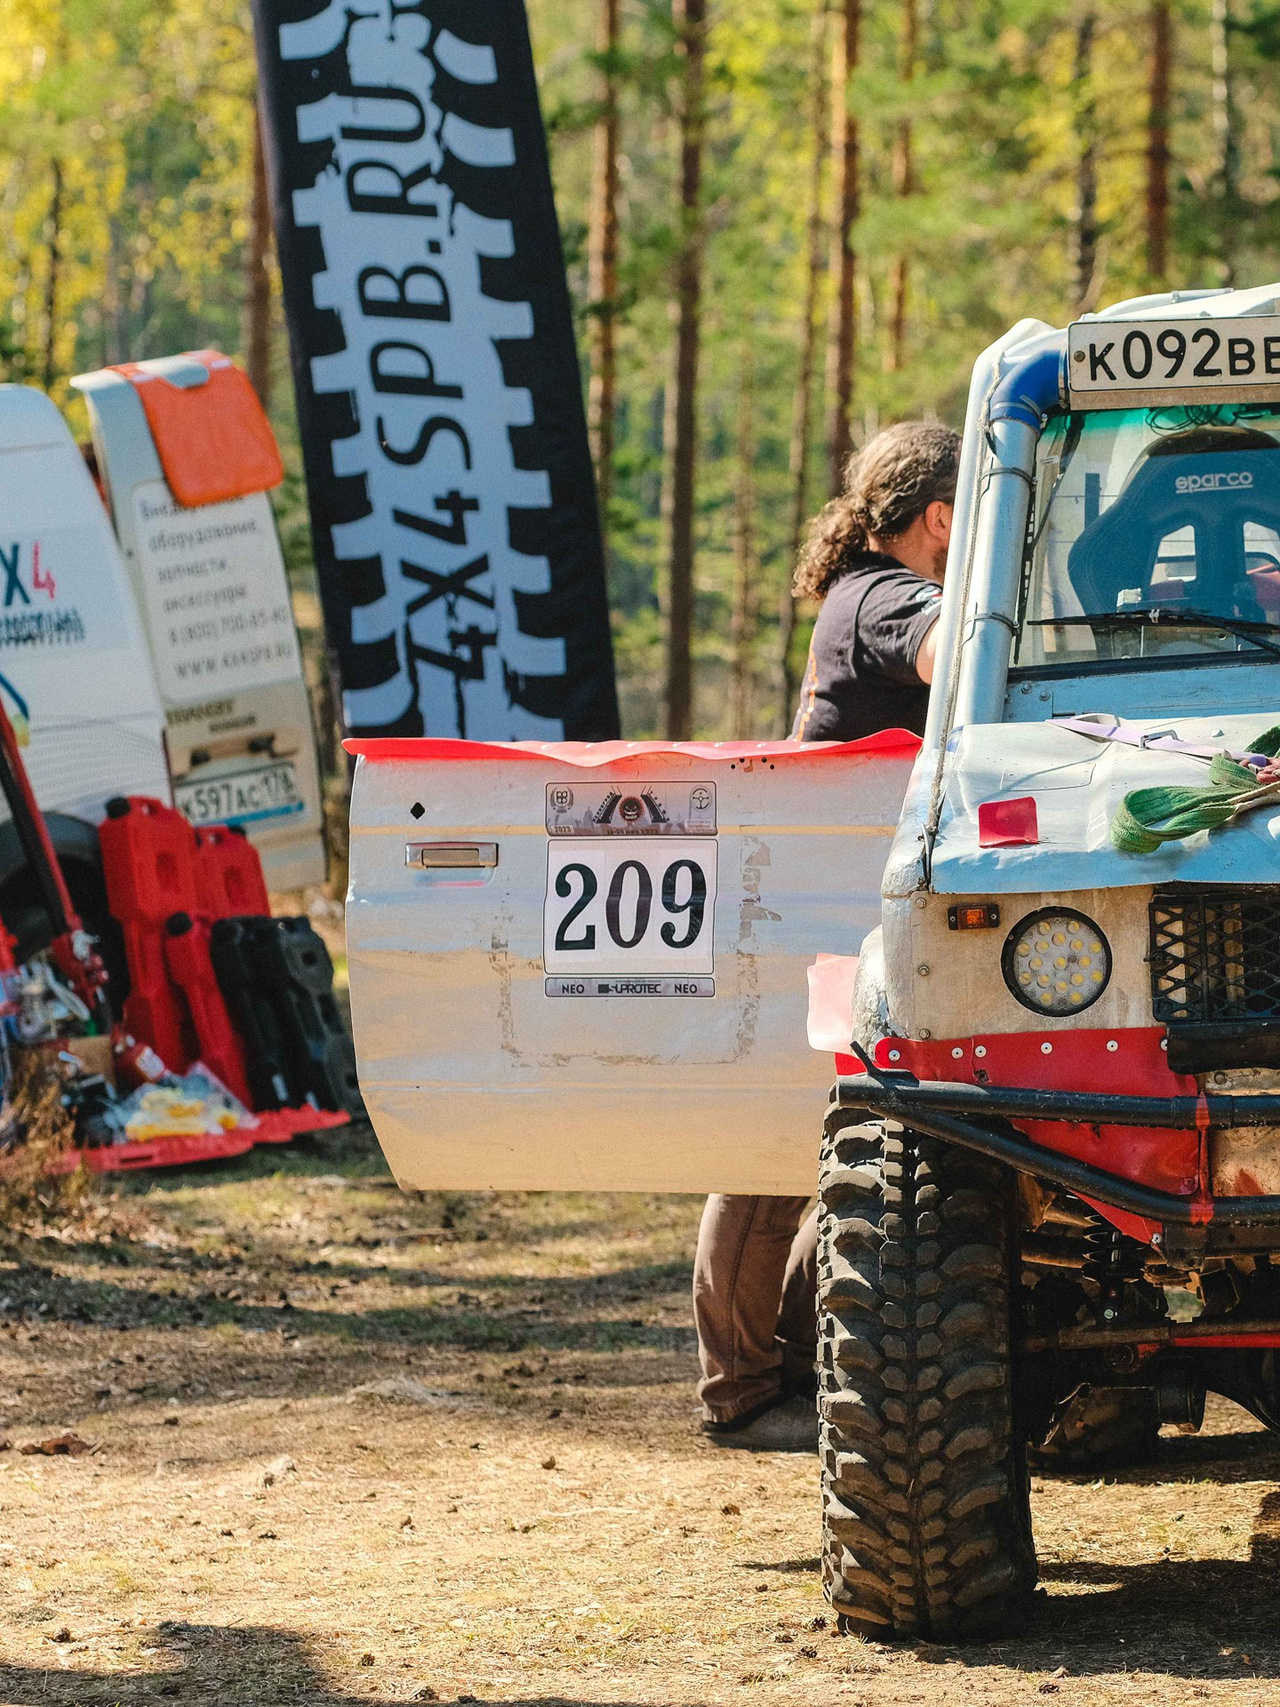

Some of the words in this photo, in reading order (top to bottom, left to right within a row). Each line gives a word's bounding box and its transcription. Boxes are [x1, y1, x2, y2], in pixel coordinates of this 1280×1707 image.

[337, 84, 498, 681] 4X4SPB.RU
[1175, 471, 1253, 493] sparco
[555, 859, 707, 951] 209
[561, 984, 585, 994] NEO
[609, 983, 662, 994] SUPROTEC
[674, 984, 698, 994] NEO
